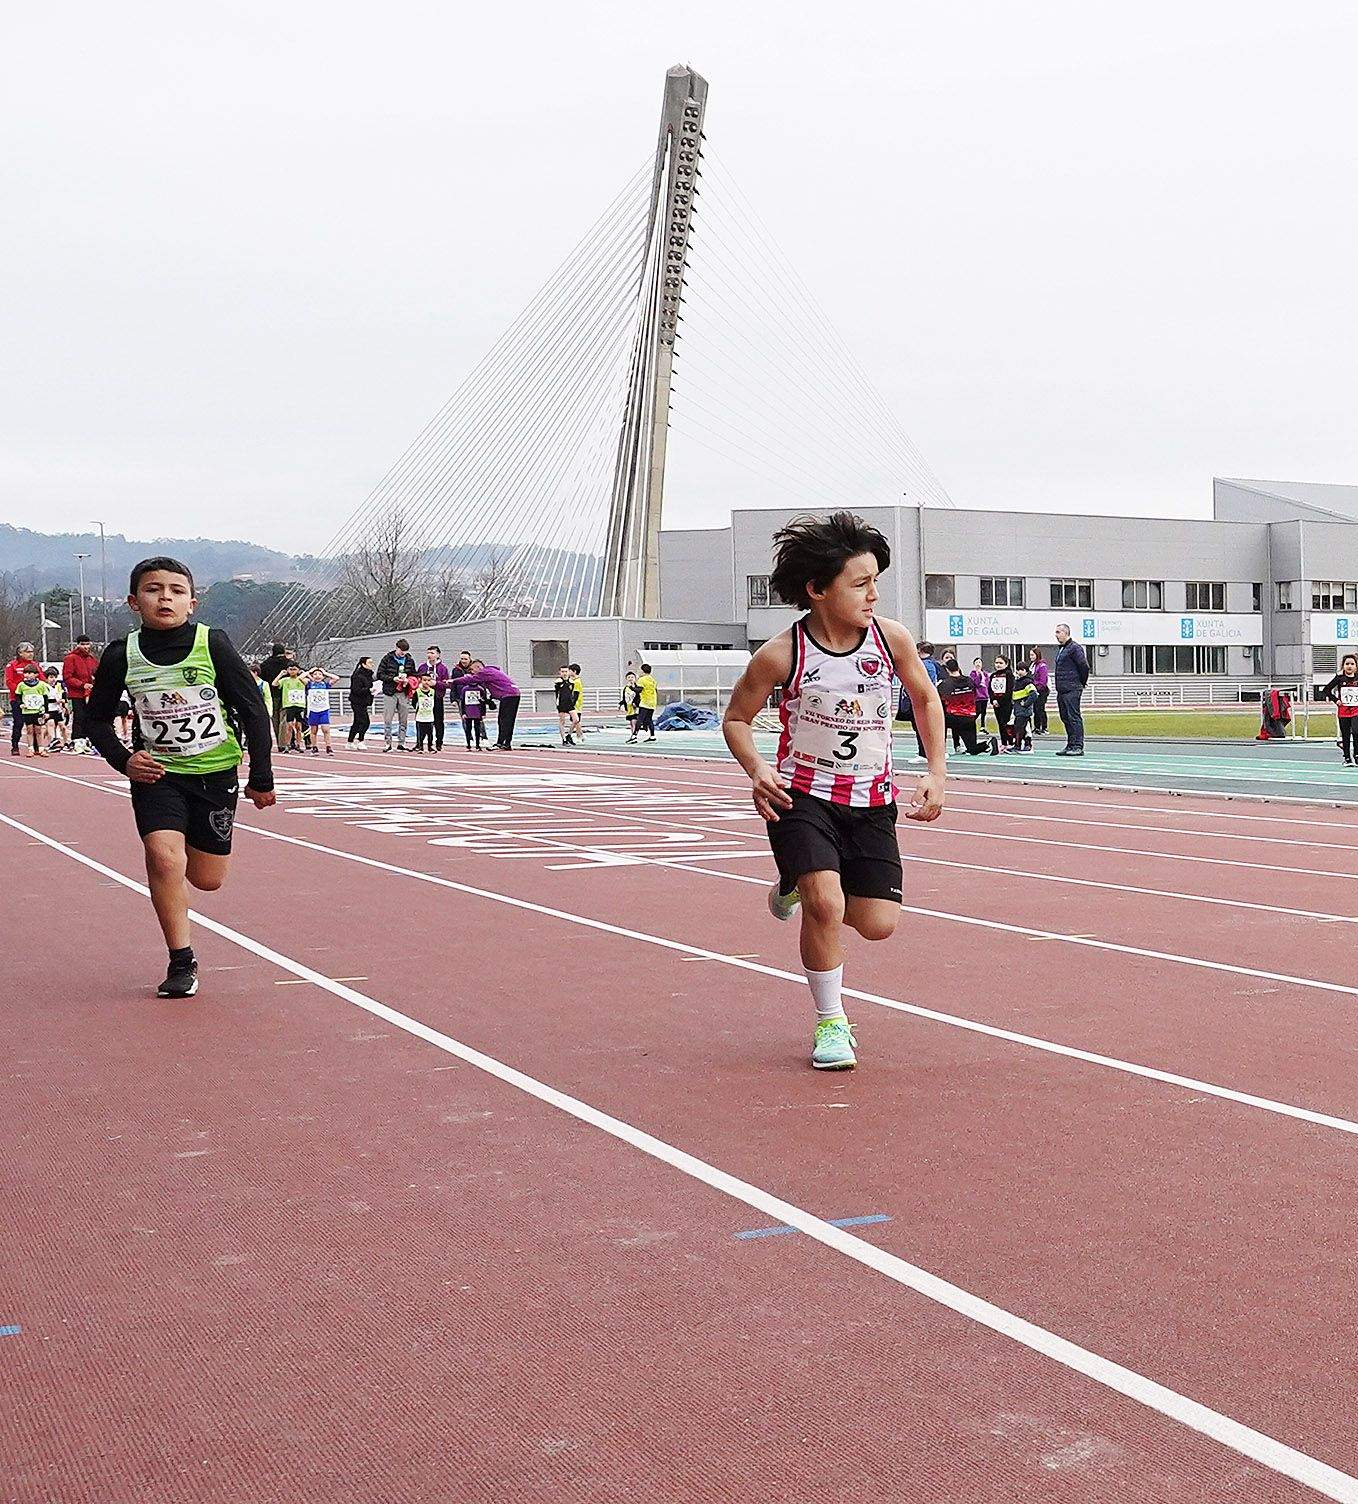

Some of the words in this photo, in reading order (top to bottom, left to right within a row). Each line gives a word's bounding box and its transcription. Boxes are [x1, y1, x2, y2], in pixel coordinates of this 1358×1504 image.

[966, 617, 999, 626] XUNTA
[1195, 619, 1224, 628] XUNTA
[966, 626, 979, 636] DE
[981, 626, 1019, 636] GALICIA
[1195, 630, 1207, 638] DE
[1209, 630, 1242, 638] GALICIA
[800, 714, 820, 725] GRAN
[152, 713, 221, 745] 232
[832, 730, 860, 761] 3
